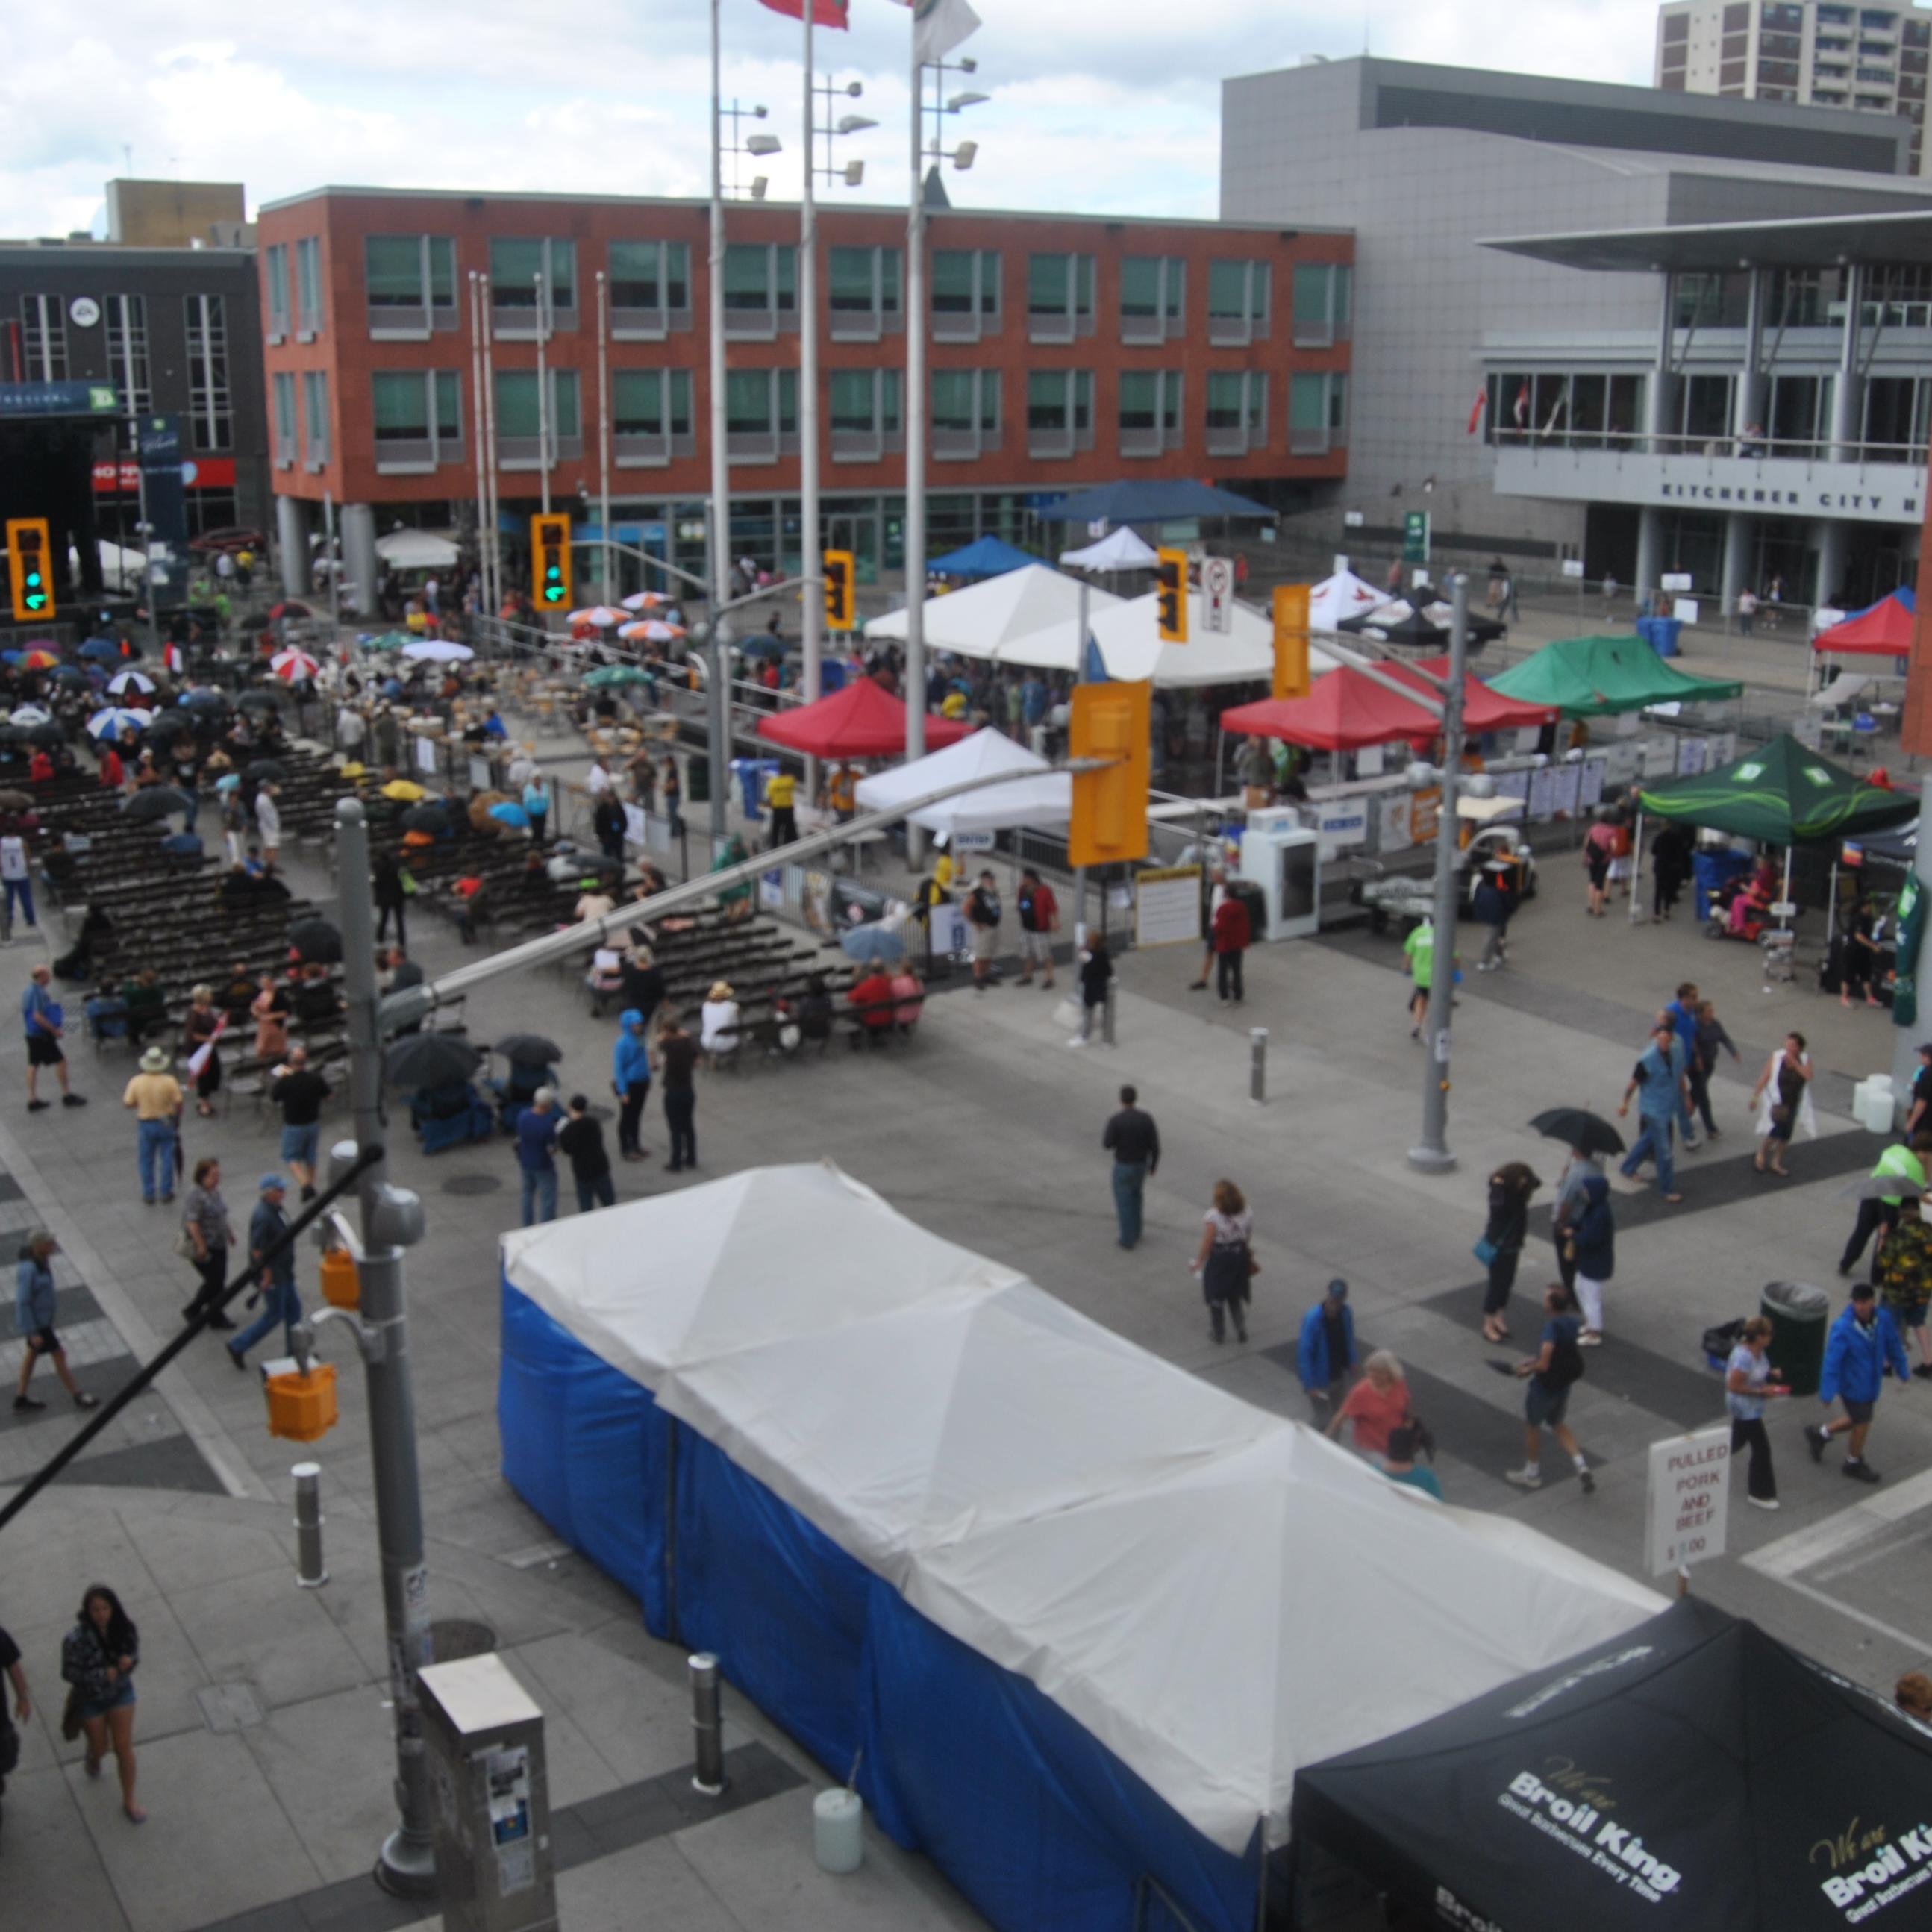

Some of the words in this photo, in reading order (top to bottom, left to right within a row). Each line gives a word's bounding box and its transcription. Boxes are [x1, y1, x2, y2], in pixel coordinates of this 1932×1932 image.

[1661, 484, 1798, 504] KITCHENER
[1819, 493, 1881, 510] CITY
[1667, 1444, 1728, 1471] PULLED
[1676, 1471, 1720, 1494] PORK
[1681, 1492, 1710, 1511] AND
[1675, 1510, 1715, 1532] BEEF
[1508, 1771, 1600, 1834] Broil
[1594, 1821, 1682, 1892] King
[1819, 1843, 1907, 1908] Broil
